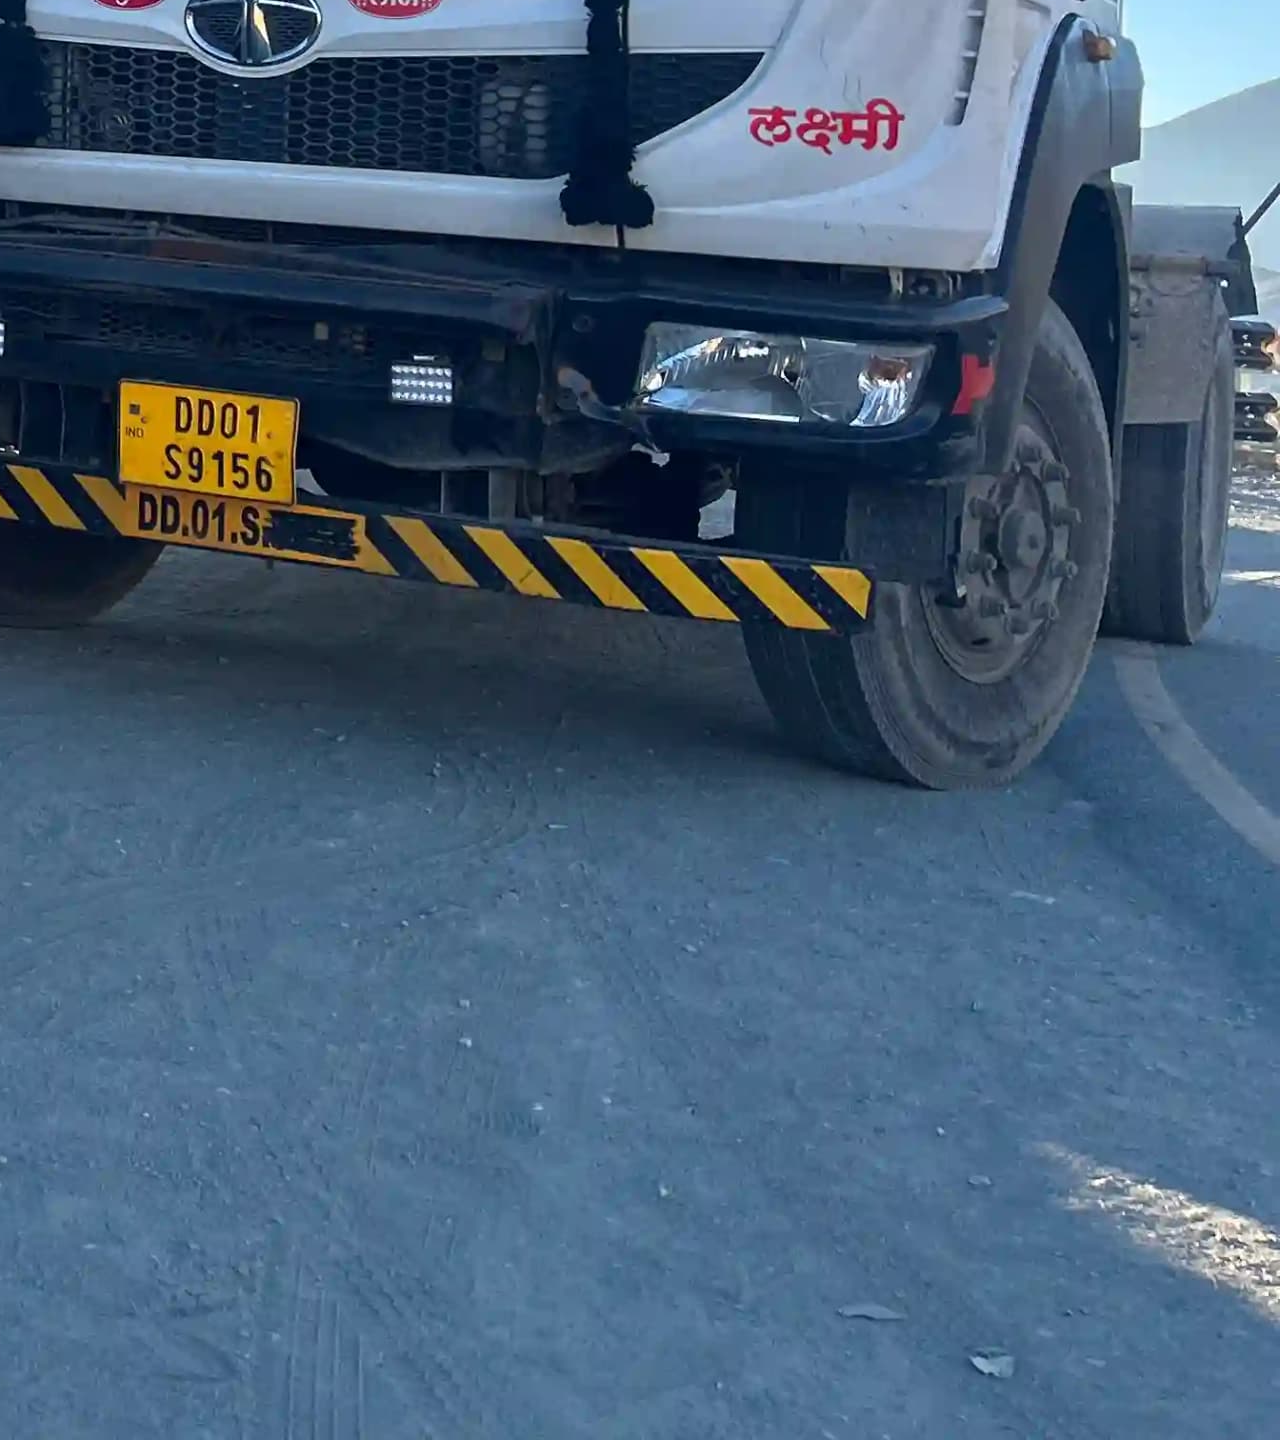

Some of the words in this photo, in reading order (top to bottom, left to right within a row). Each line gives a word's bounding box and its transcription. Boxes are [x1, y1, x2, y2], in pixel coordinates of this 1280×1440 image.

[124, 425, 145, 439] IND
[175, 396, 262, 444] DD01
[164, 443, 274, 493] S9156
